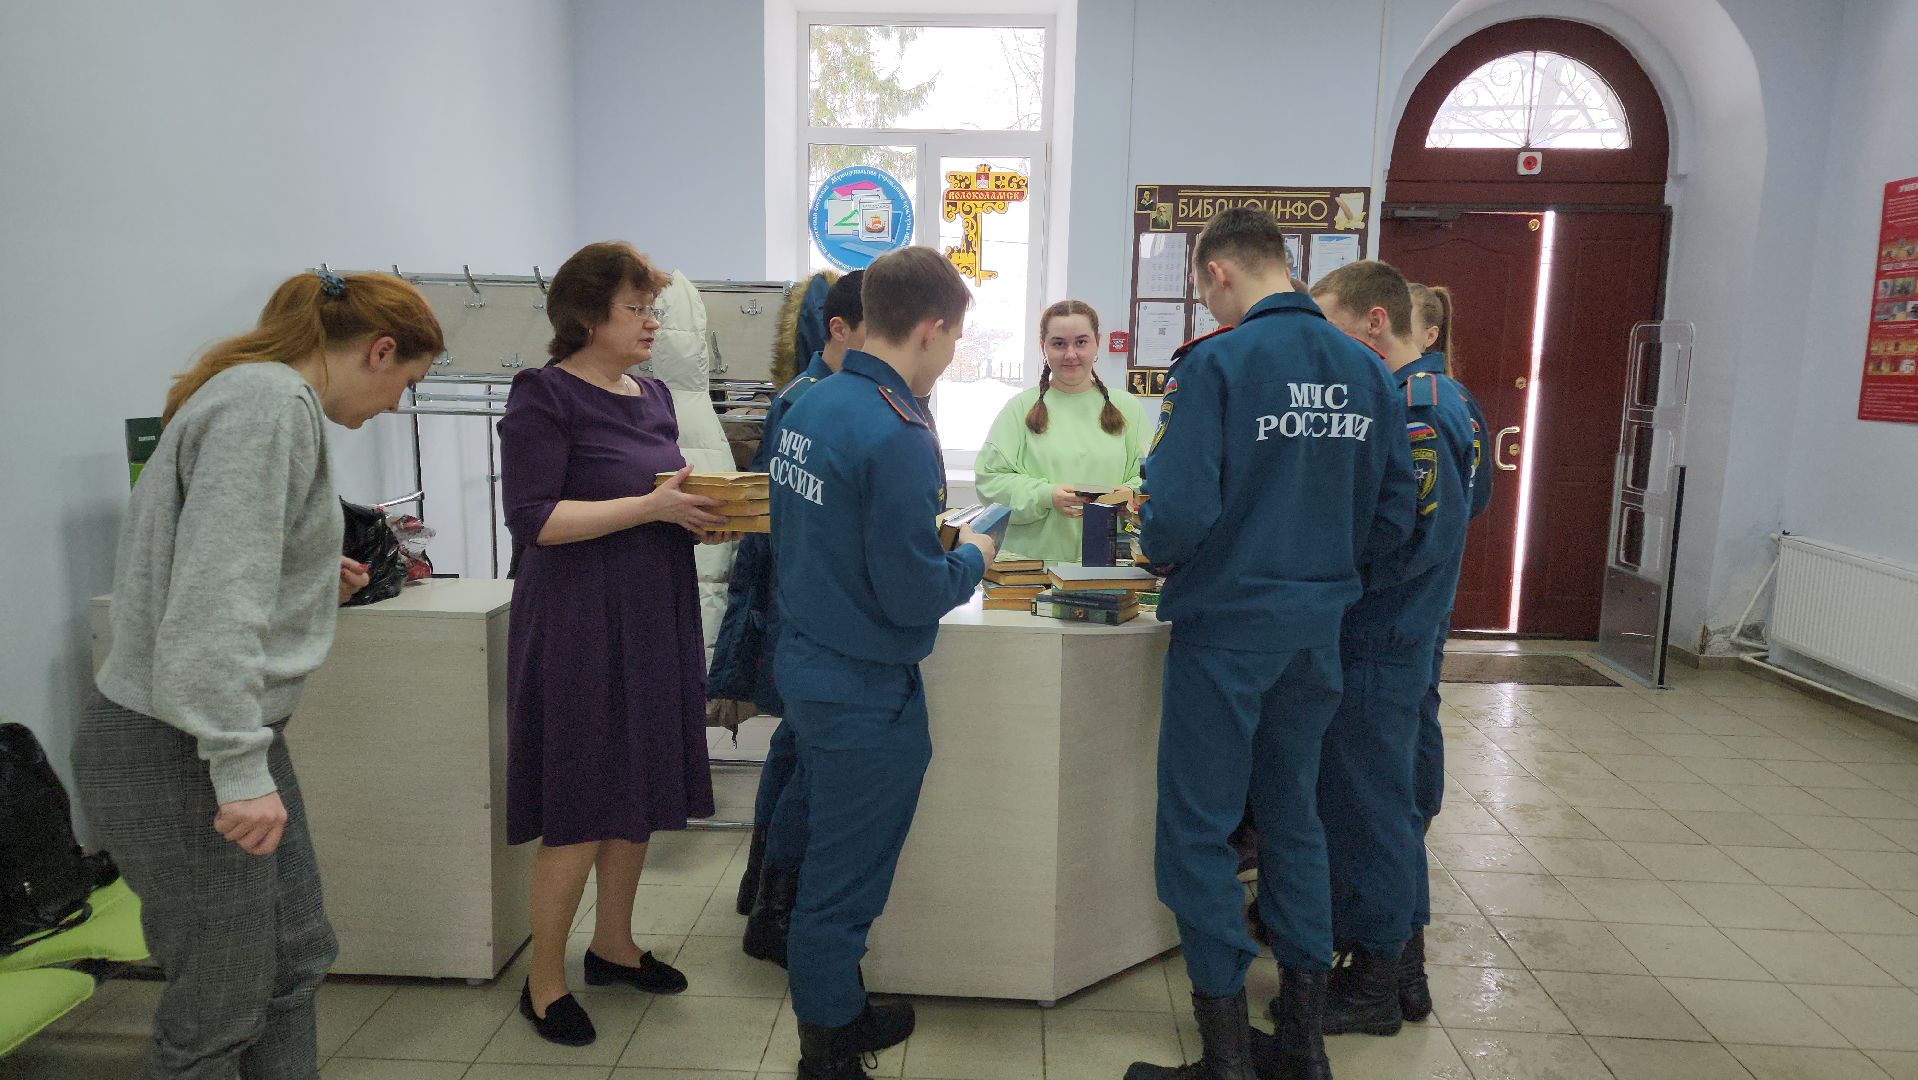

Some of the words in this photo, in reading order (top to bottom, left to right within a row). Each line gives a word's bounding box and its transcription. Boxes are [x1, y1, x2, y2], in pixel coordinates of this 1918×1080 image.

[948, 191, 1020, 200] ВОЛОКОЛАМСК
[1287, 382, 1348, 409] МЧС
[1256, 411, 1373, 441] РОССИИ
[778, 428, 811, 464] МЧС
[769, 456, 824, 505] ОССИИ
